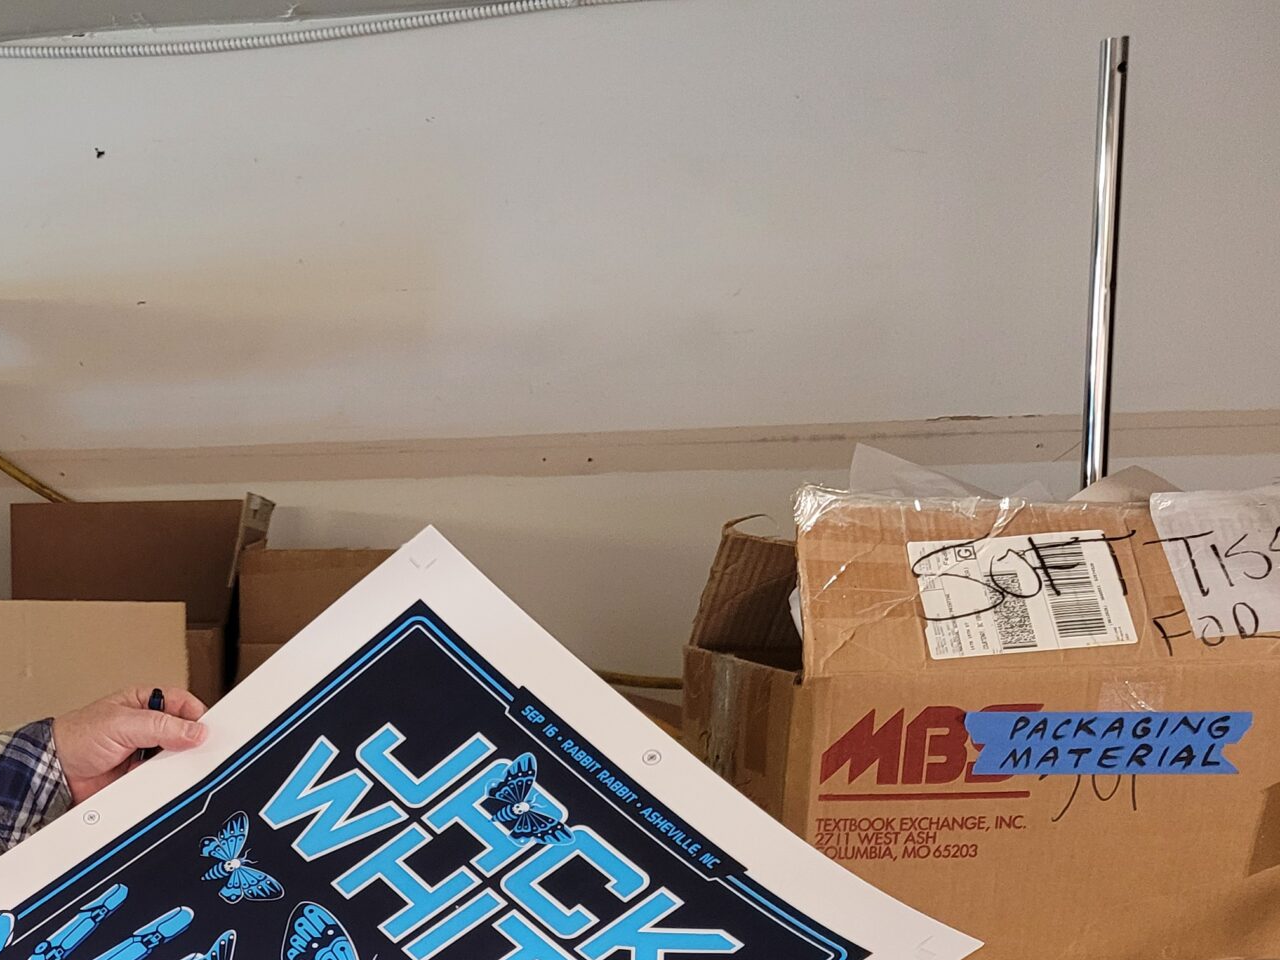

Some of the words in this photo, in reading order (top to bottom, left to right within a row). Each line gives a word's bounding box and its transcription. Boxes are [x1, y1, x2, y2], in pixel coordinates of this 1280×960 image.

[1142, 526, 1280, 597] TIS
[1009, 715, 1232, 741] PACKAGING
[999, 744, 1221, 770] MATERIAL
[521, 705, 546, 725] SEP
[542, 723, 559, 738] 16
[560, 739, 603, 774] RABBIT
[596, 769, 639, 804] RABBIT
[639, 807, 703, 858] ASHEVILLE,
[699, 852, 721, 870] NC
[815, 817, 897, 833] TEXTBOOK
[900, 815, 990, 832] EXCHANGE,
[994, 815, 1027, 830] INC.
[815, 832, 850, 846] 2711
[857, 832, 901, 845] WEST
[903, 831, 937, 845] ASH
[816, 846, 898, 862] OLUMBIA,
[901, 845, 931, 859] MO
[934, 843, 978, 859] 65203
